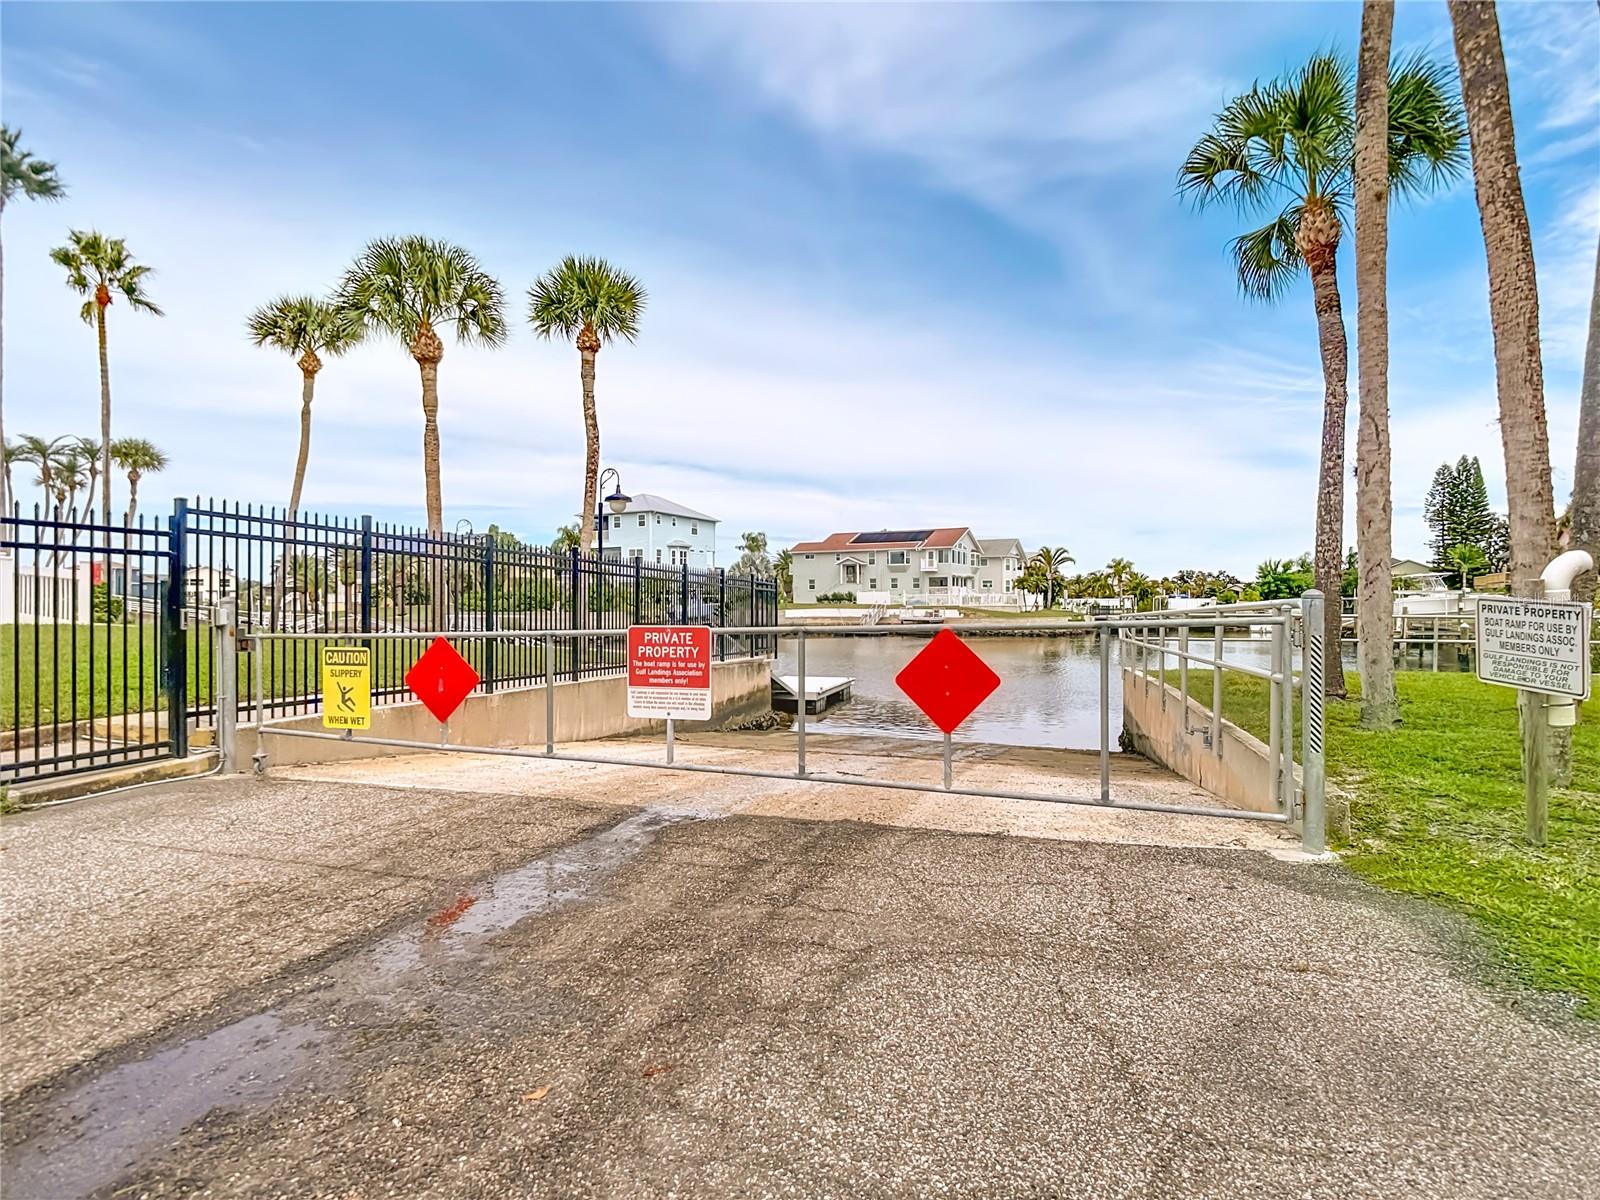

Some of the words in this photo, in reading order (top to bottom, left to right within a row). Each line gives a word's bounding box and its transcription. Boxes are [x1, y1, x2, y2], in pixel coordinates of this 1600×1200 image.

[1481, 604, 1520, 616] PRIVATE
[1523, 607, 1581, 621] PROPERTY
[1484, 617, 1503, 627] BOAT
[1504, 618, 1526, 629] RAMP
[1528, 621, 1544, 631] FOR
[1546, 623, 1563, 633] USE
[1565, 624, 1577, 635] BY
[644, 632, 693, 644] PRIVATE
[1485, 628, 1504, 638] GULF
[1505, 630, 1544, 643] LANDINGS
[1546, 635, 1577, 647] ASSOC.
[638, 646, 699, 658] PROPERTY
[1499, 640, 1536, 654] MEMBERS
[1538, 645, 1560, 656] ONLY
[326, 651, 367, 664] CAUTION
[698, 661, 705, 670] by
[1483, 652, 1503, 660] GULF
[1505, 655, 1547, 667] LANDINGS
[1560, 663, 1580, 672] NOT
[330, 669, 363, 678] SLIPPERY
[647, 669, 672, 677] Landings
[673, 669, 703, 677] Association
[1491, 660, 1549, 674] RESPONSIBLE
[1551, 668, 1570, 677] FOR
[1493, 665, 1529, 676] DAMAGE
[1530, 671, 1541, 679] TO
[1543, 673, 1568, 683] YOUR
[1489, 671, 1522, 681] VEHICLE
[1525, 676, 1537, 684] OR
[1539, 679, 1573, 690] VESSEL
[328, 715, 348, 725] WHEN
[350, 716, 365, 726] WET
